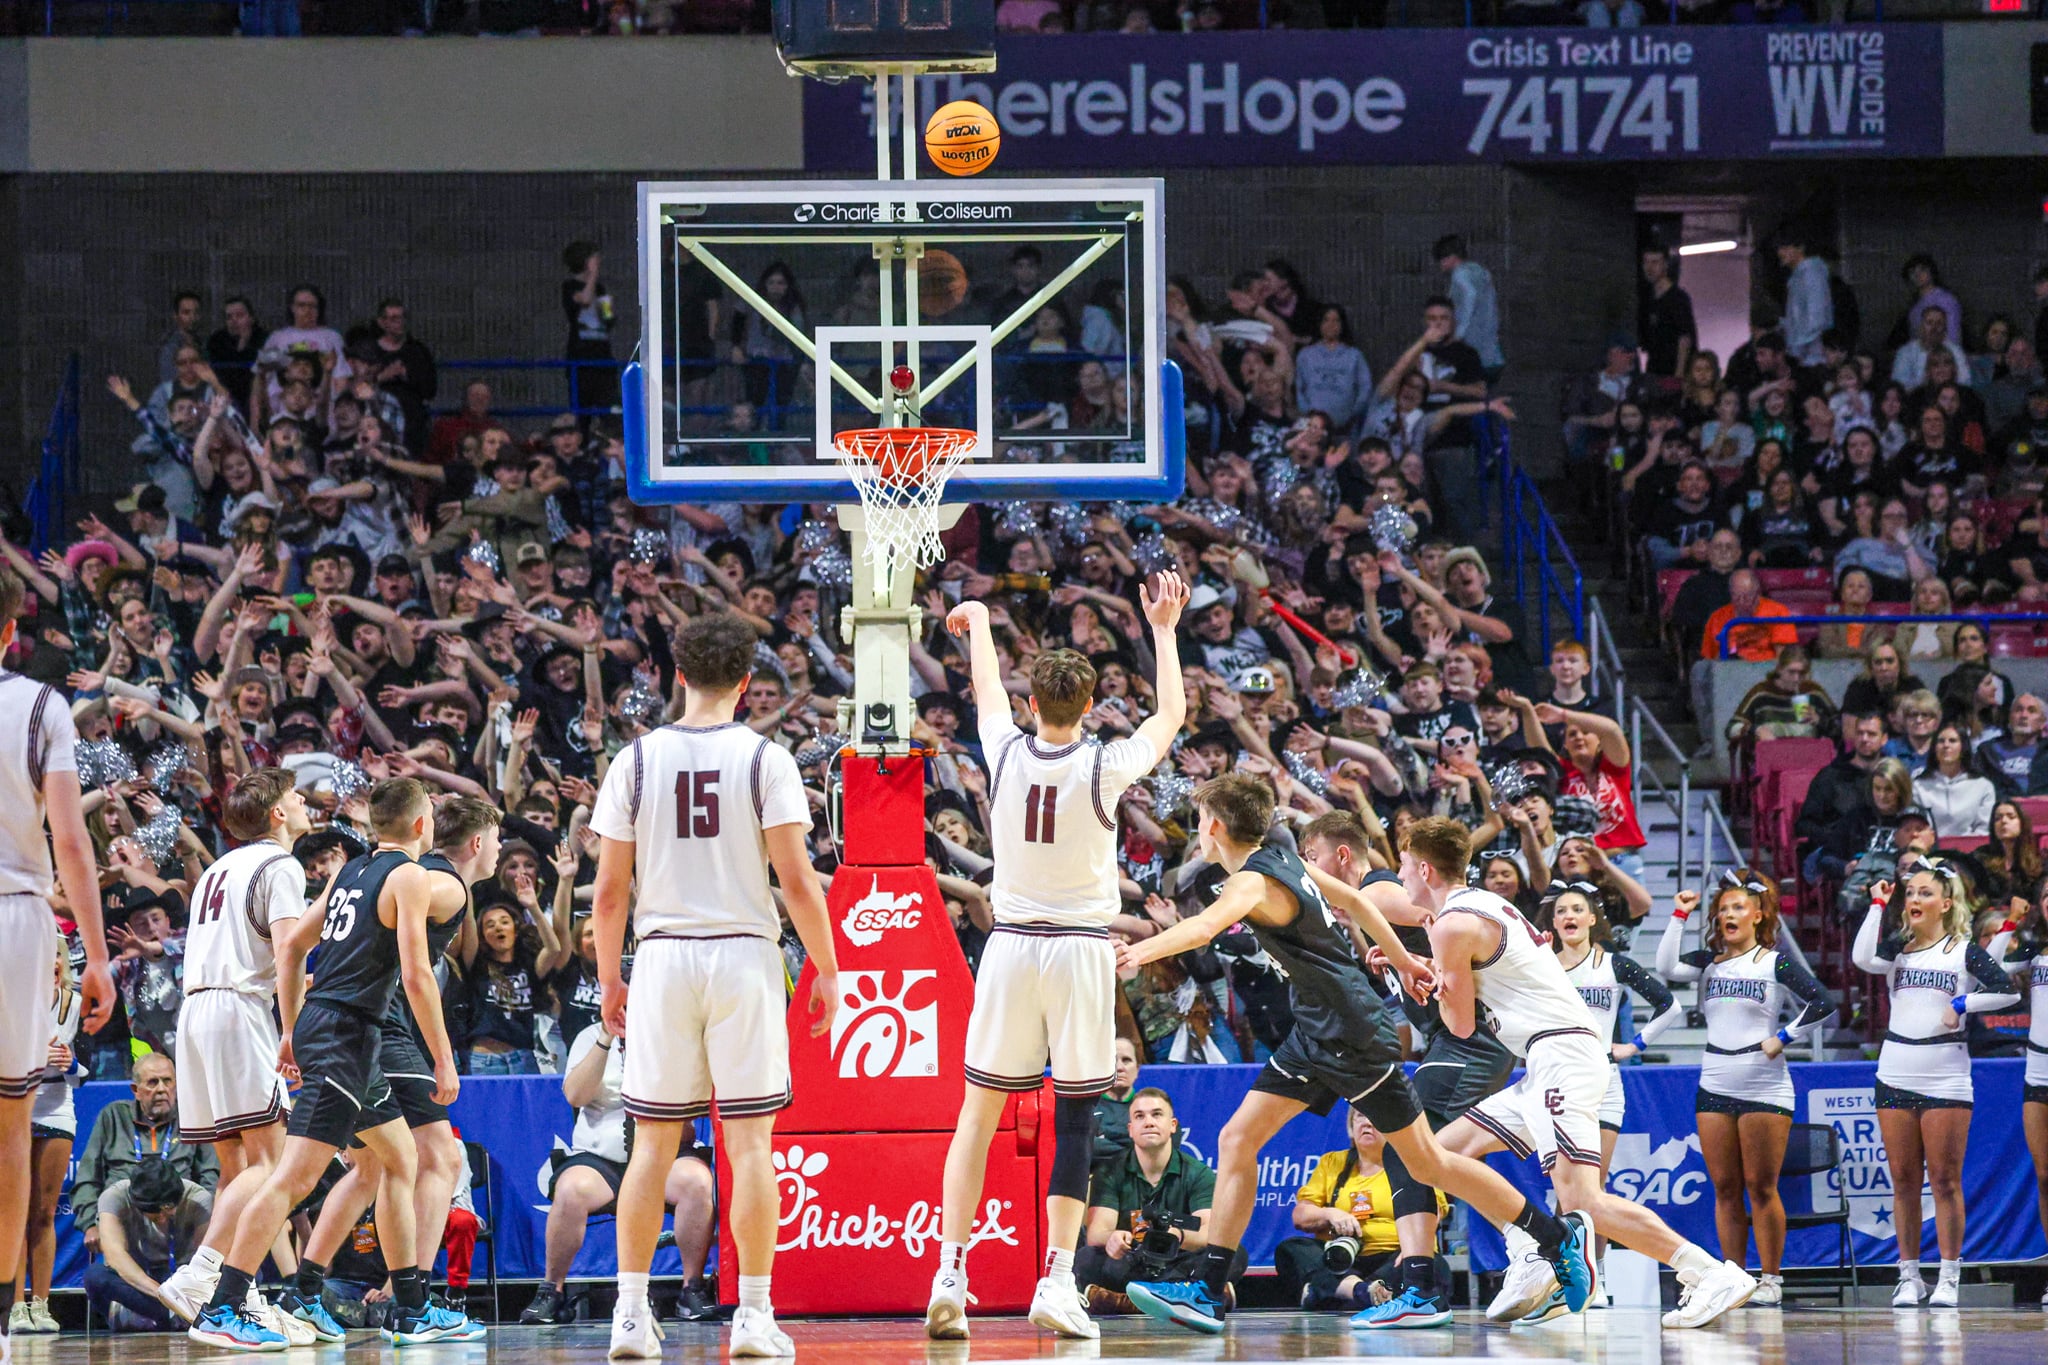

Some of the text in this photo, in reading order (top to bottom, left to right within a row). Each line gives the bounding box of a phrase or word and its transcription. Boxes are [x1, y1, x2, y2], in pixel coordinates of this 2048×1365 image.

[1467, 35, 1693, 67] Crisis Text Line
[1768, 32, 1857, 62] PREVENT
[1859, 32, 1884, 134] SUICIDE
[1463, 74, 1699, 155] 741741
[1768, 64, 1856, 135] WV
[946, 124, 981, 139] NCAA
[942, 146, 990, 163] Wilson
[928, 203, 1012, 220] Coliseum
[674, 770, 720, 838] 15
[1025, 784, 1057, 844] 11
[198, 869, 229, 925] 14
[320, 888, 363, 941] 35
[856, 910, 922, 930] SSAC
[1706, 977, 1765, 1003] RENEGADES
[1894, 968, 1958, 995] RENEGADES
[1825, 1097, 1863, 1108] WEST
